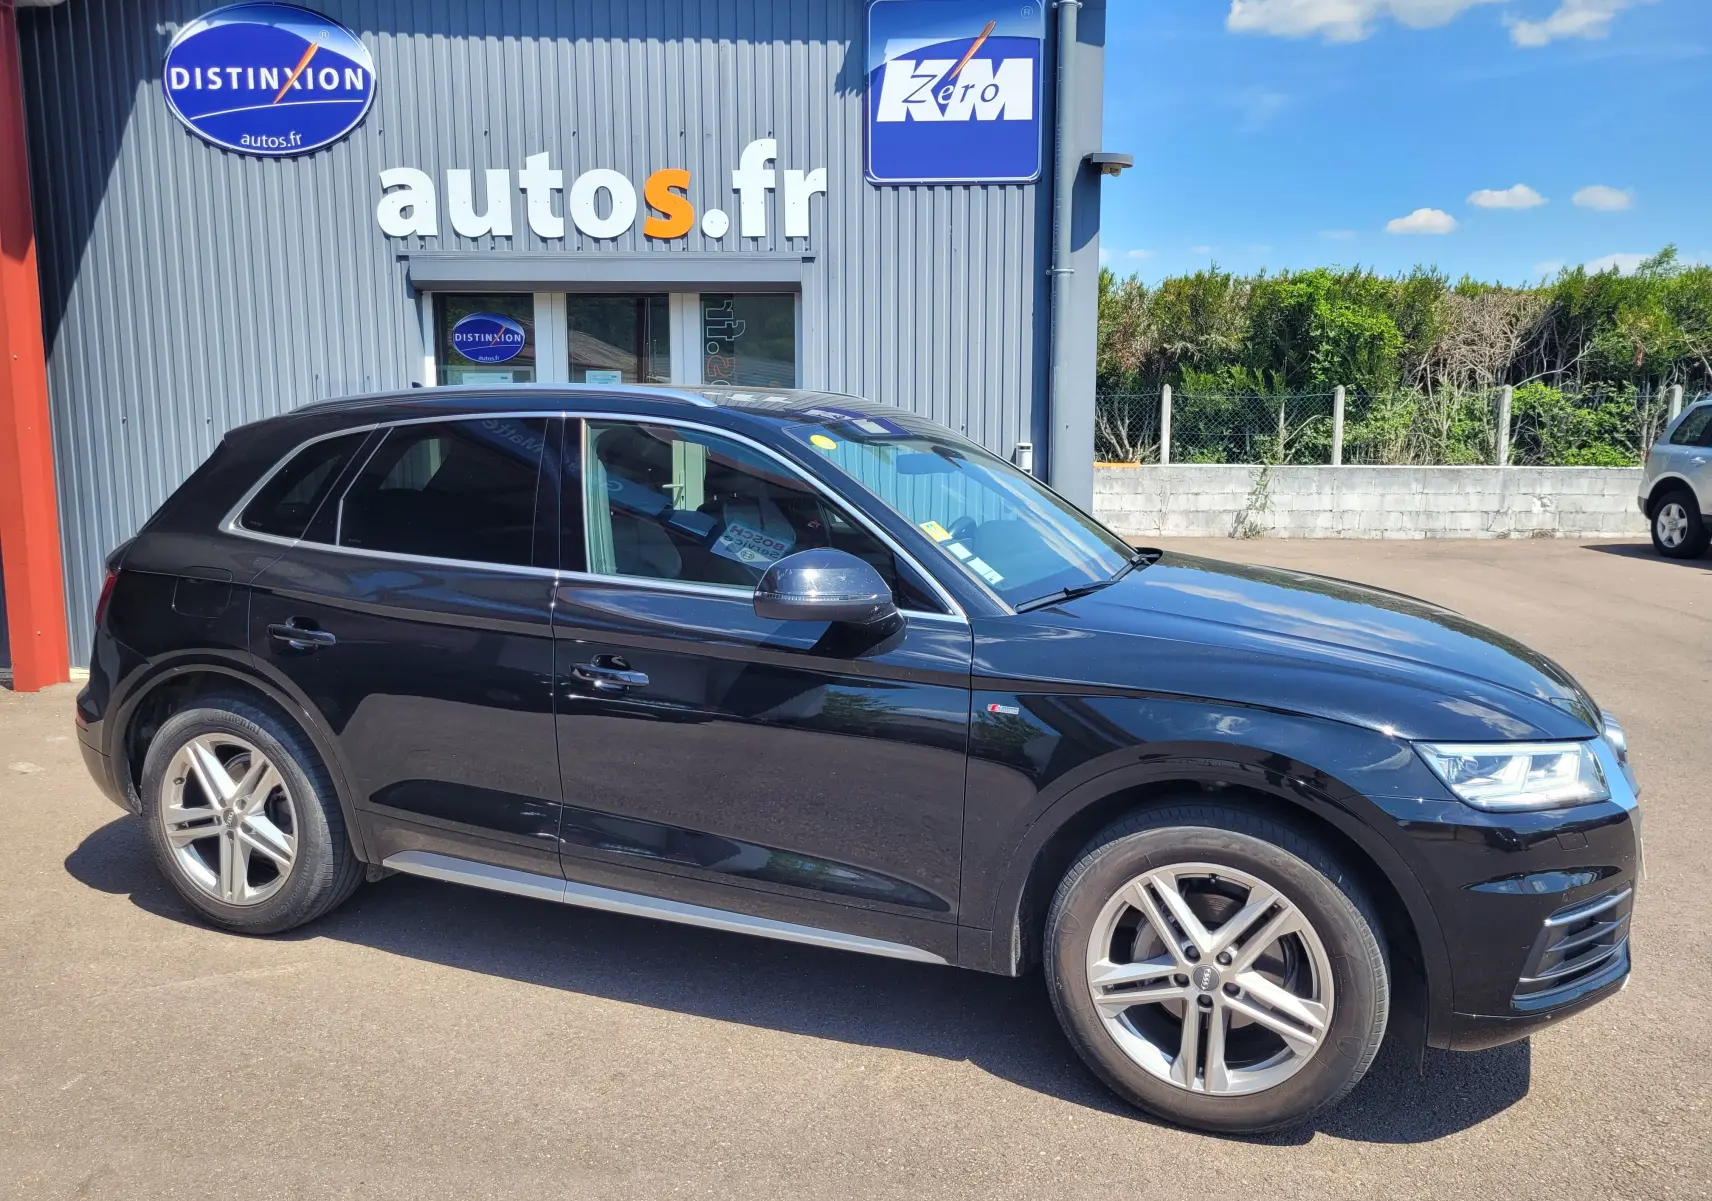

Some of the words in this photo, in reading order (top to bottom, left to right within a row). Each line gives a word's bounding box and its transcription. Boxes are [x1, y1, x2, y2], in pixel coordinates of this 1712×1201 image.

[171, 67, 364, 91] DISTINXION
[876, 58, 1033, 122] KM
[902, 74, 1000, 105] Zero
[240, 131, 302, 148] autos.fr
[377, 138, 827, 239] autos.fr
[455, 333, 521, 342] DISTINXION
